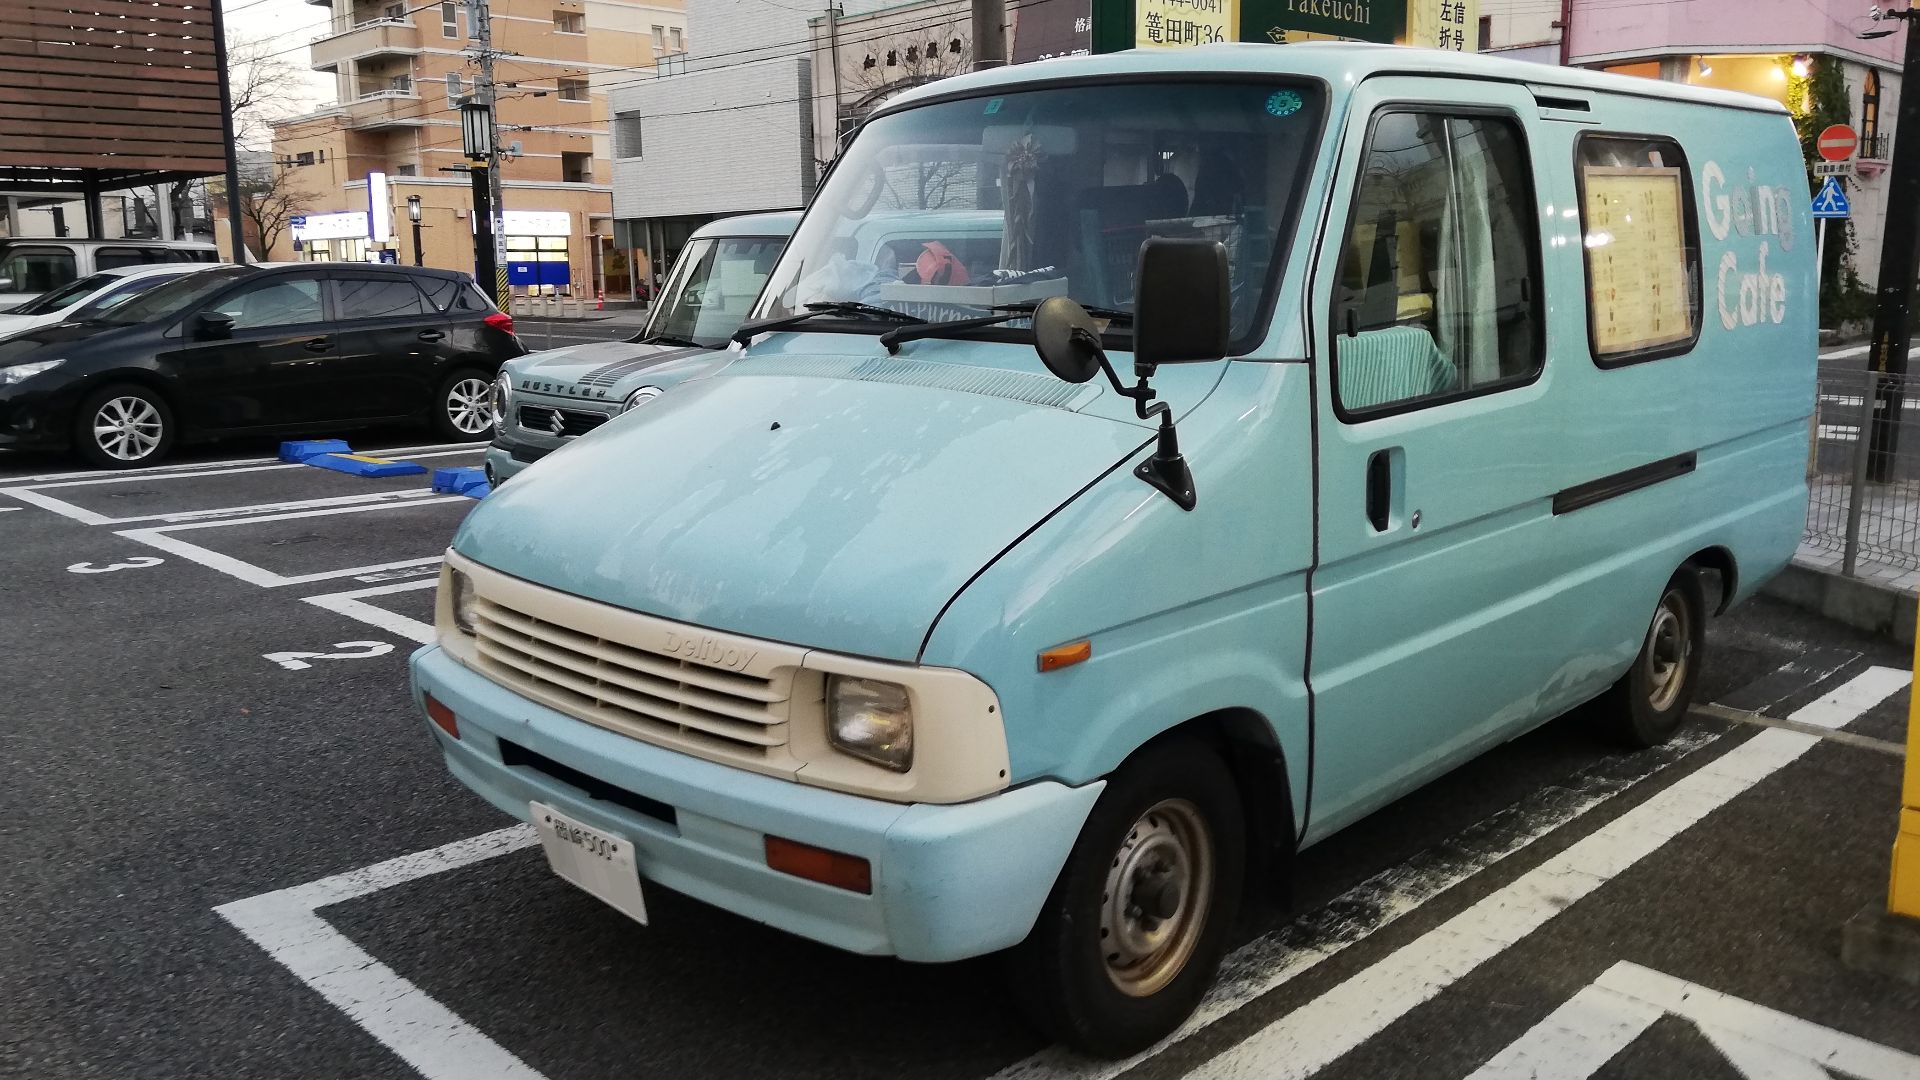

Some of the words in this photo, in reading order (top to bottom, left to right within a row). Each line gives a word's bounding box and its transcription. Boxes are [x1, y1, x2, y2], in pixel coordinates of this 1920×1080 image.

[1702, 160, 1794, 252] Going
[1718, 241, 1786, 331] Cafe
[522, 380, 607, 398] HUSTLER
[262, 640, 395, 671] 2
[663, 631, 759, 672] Deliboy
